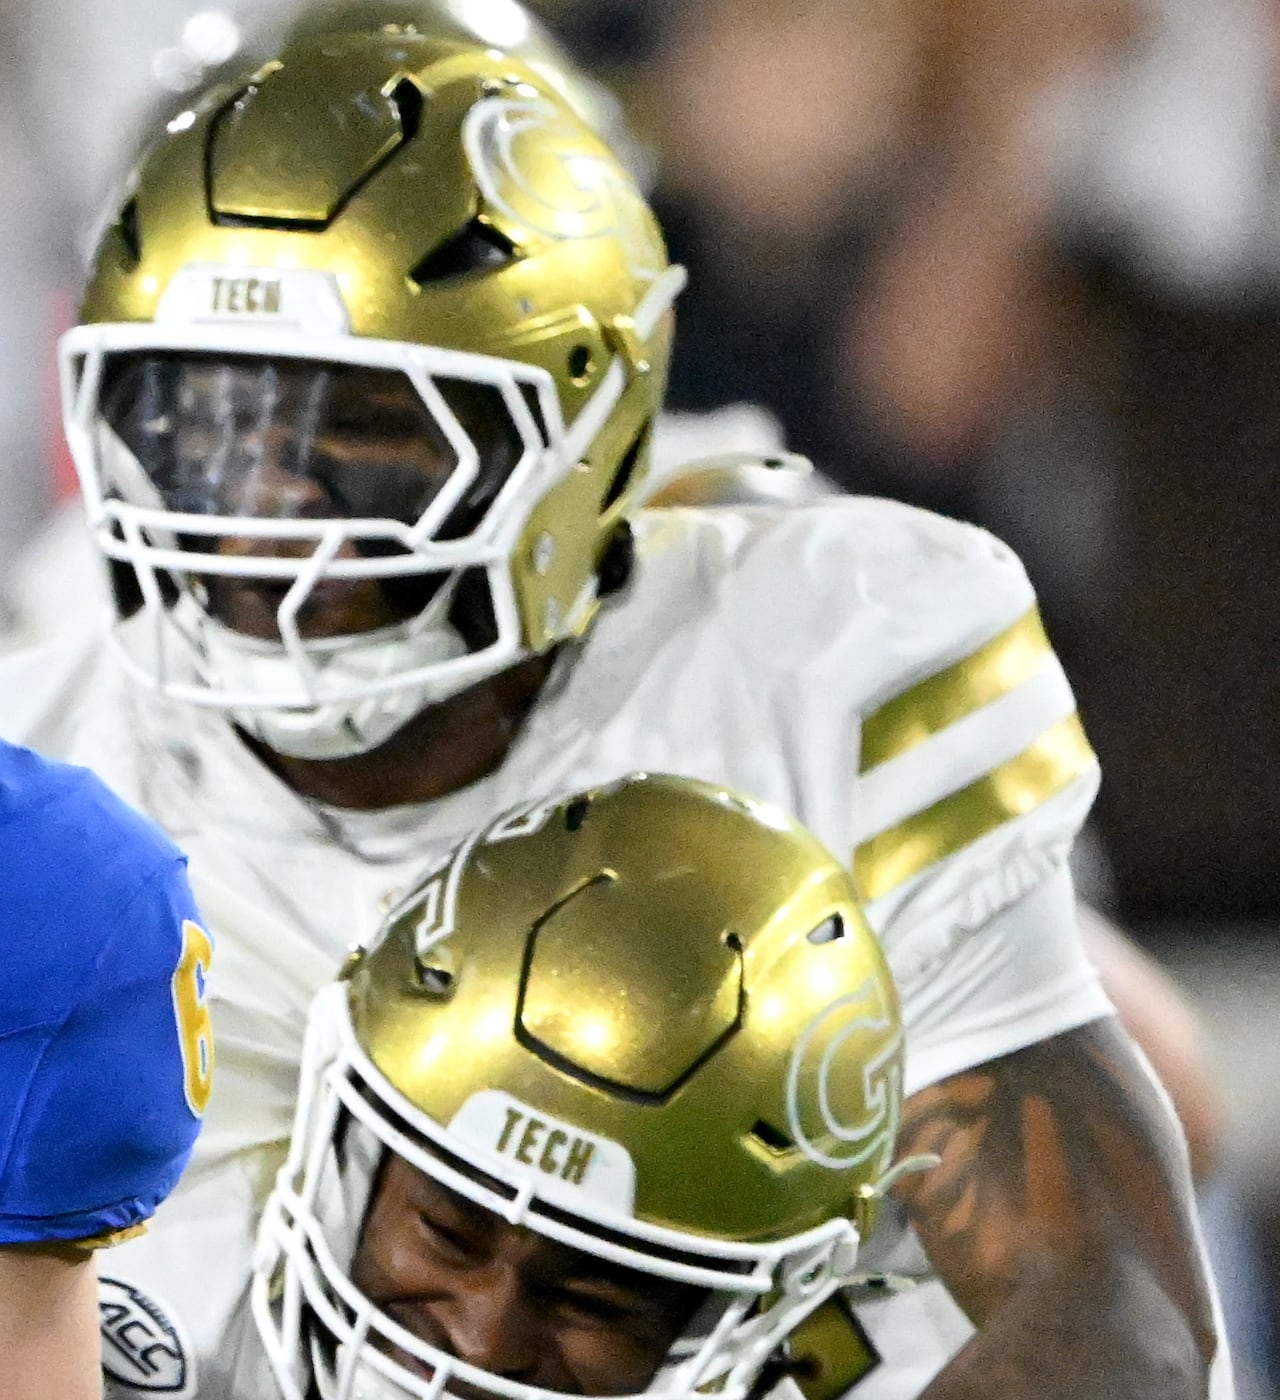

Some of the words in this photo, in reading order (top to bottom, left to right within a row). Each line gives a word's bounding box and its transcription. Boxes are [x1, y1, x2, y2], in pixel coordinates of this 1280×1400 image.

[211, 277, 282, 314] TECH
[171, 919, 216, 1120] 6
[495, 1105, 596, 1186] TECH
